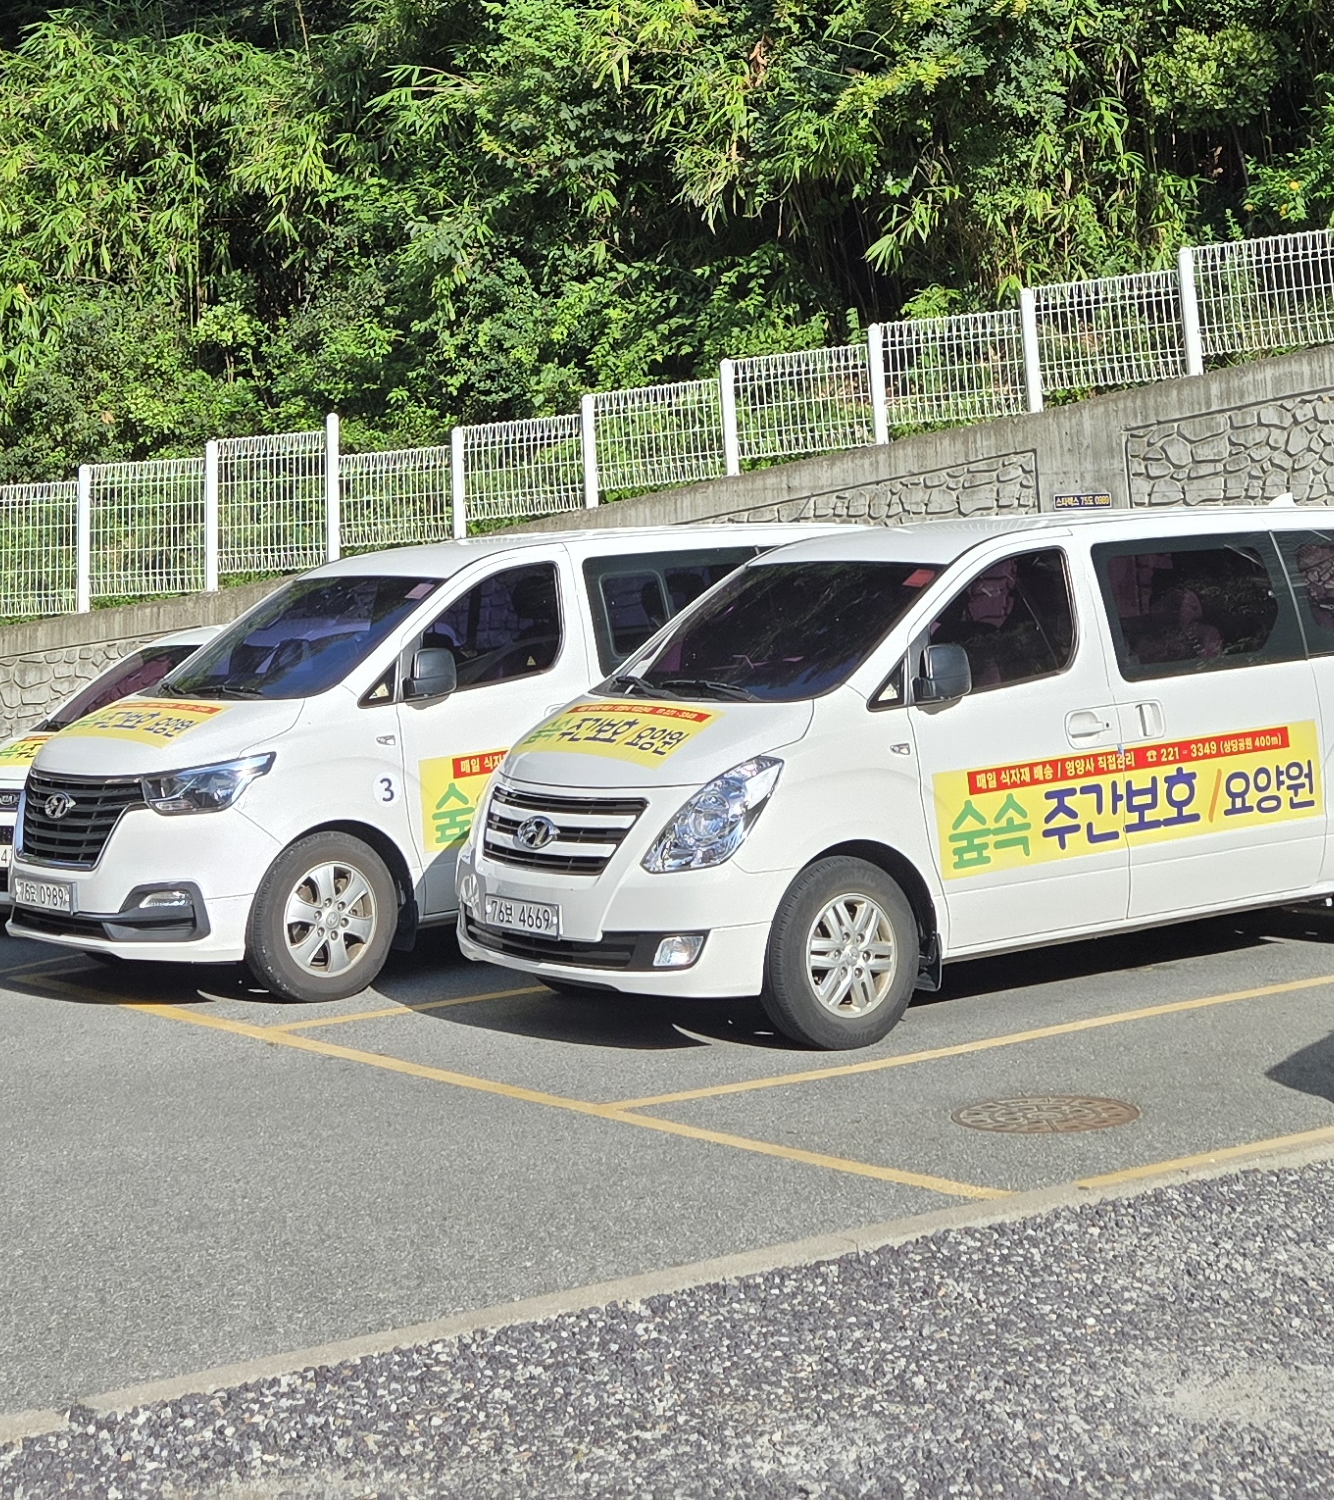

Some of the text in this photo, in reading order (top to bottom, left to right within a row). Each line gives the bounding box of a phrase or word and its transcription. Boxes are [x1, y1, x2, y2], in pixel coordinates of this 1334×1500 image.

[1056, 496, 1080, 507] 스타렉스
[556, 717, 640, 743] 주간보호
[624, 726, 690, 756] 요양원
[460, 758, 481, 774] 매일
[976, 771, 998, 790] 매일
[1000, 767, 1031, 786] 식자재
[1033, 763, 1054, 781] 배송
[1065, 757, 1095, 776] 영양사
[1097, 751, 1135, 771] 직접관리
[1160, 746, 1180, 763] 221
[1190, 740, 1218, 758] 3349
[1220, 736, 1254, 755] (상당공원
[1254, 733, 1283, 748] 400m)
[379, 777, 396, 803] 3
[948, 792, 1032, 870] 숲속
[1041, 766, 1201, 851] 주간보호
[1223, 759, 1316, 817] 요양원
[40, 885, 64, 908] 0989
[491, 900, 551, 931] 76보 4669
